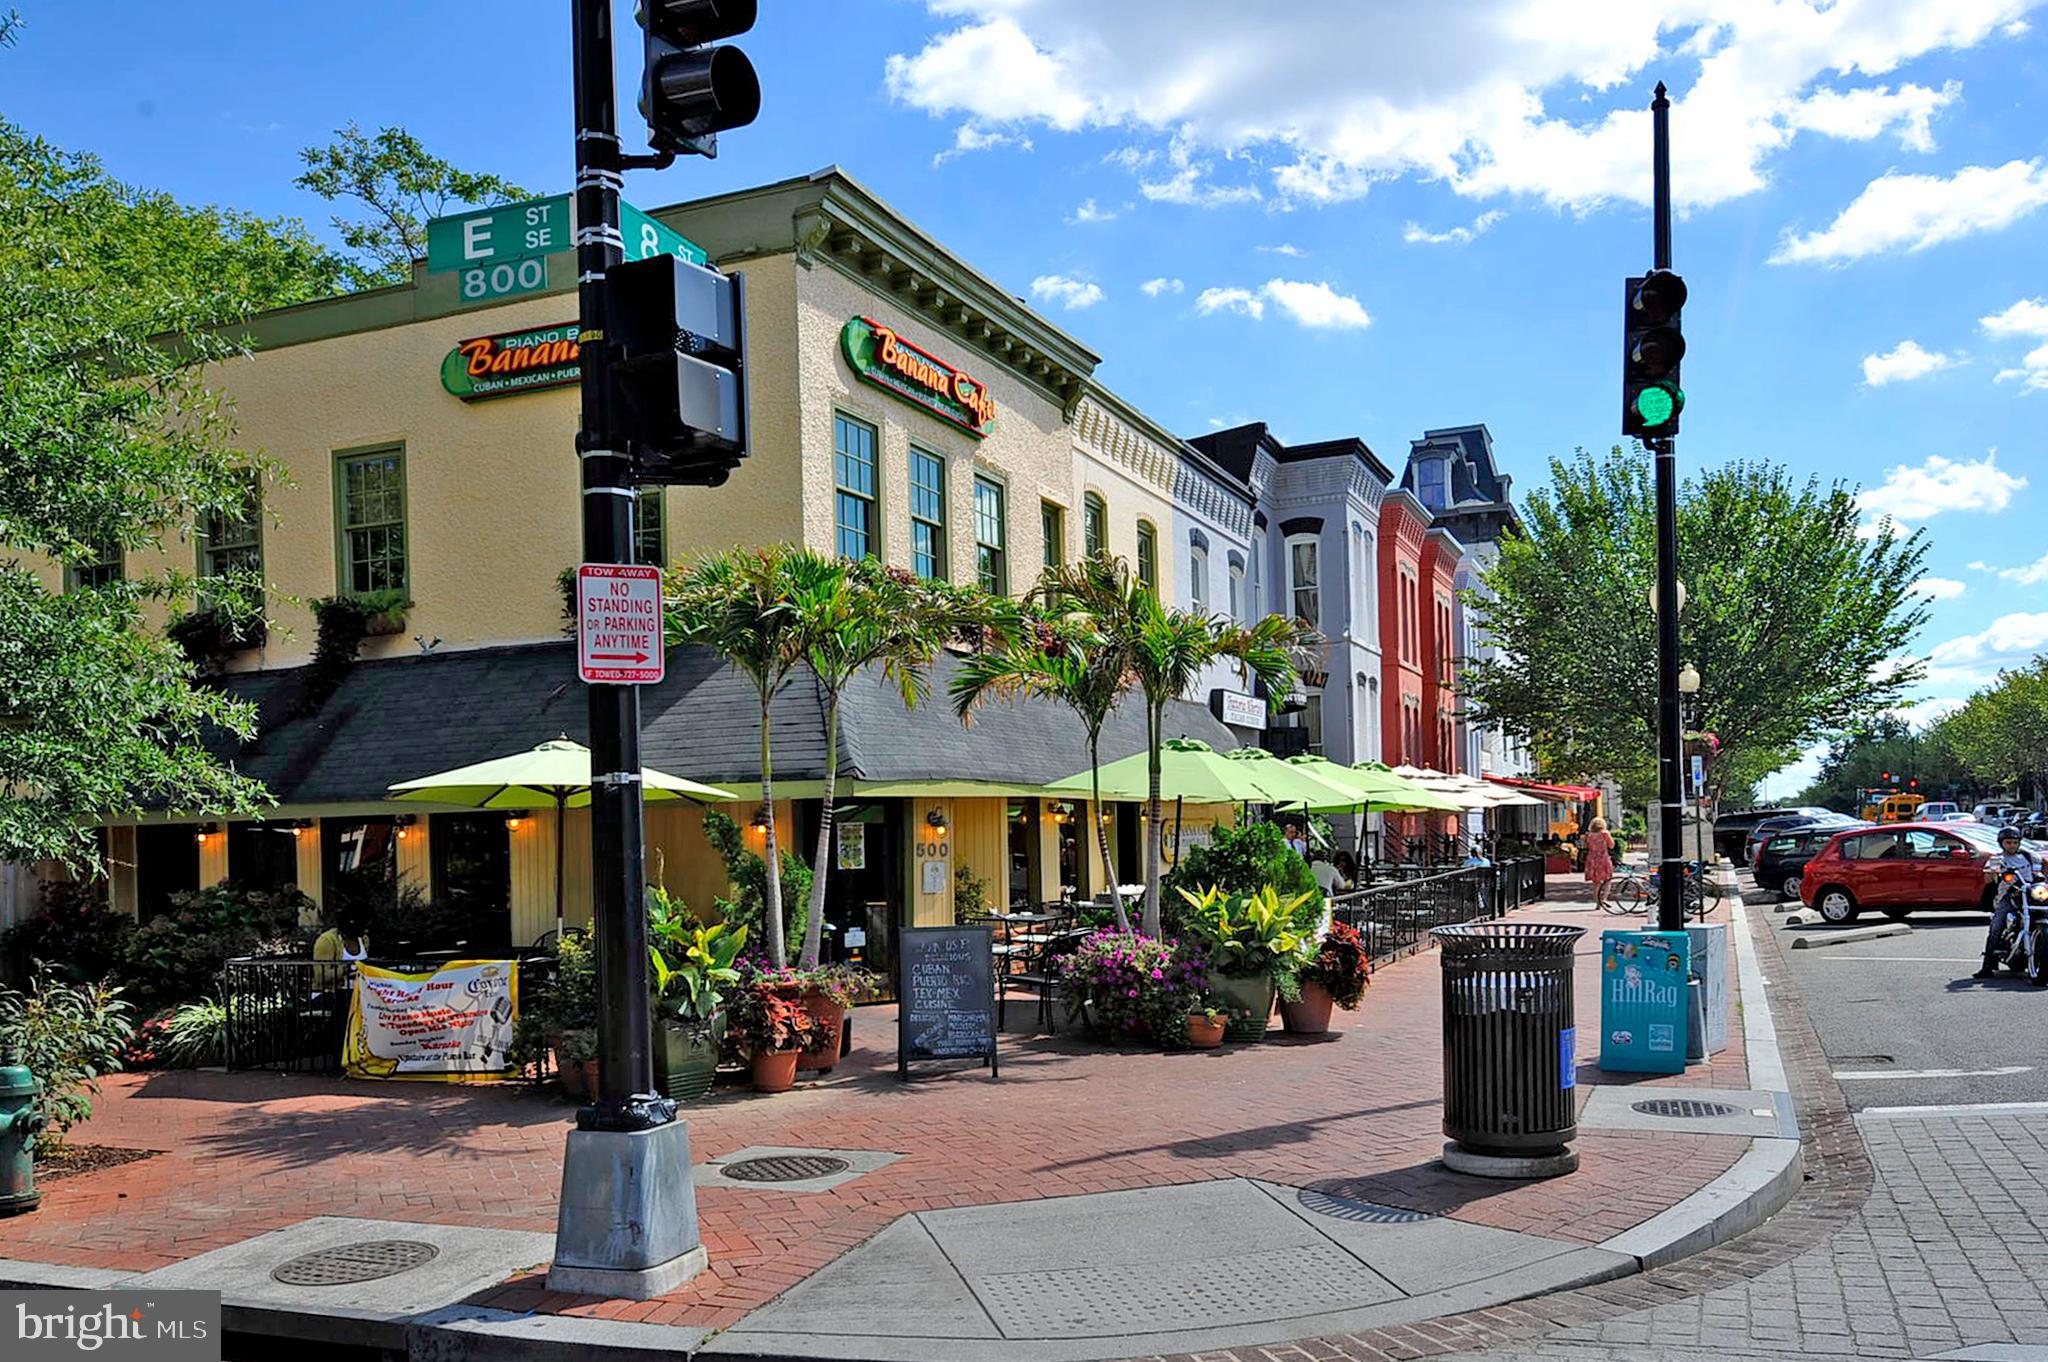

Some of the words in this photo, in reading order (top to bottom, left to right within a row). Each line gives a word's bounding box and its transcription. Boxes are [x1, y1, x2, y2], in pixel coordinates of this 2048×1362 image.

[463, 217, 494, 260] E
[525, 204, 552, 226] ST
[525, 228, 552, 249] SE
[641, 223, 659, 259] 8
[678, 244, 694, 262] ST
[463, 259, 543, 298] 800
[505, 331, 560, 349] PIANO
[875, 327, 951, 398] Banana
[473, 379, 504, 393] CUBAN
[510, 372, 550, 387] MEXICAN
[586, 567, 614, 576] TOW
[610, 582, 629, 597] NO
[588, 598, 653, 614] STANDING
[586, 618, 600, 631] OR
[604, 616, 655, 632] PARKING
[594, 634, 650, 649] ANYTIME
[916, 843, 948, 857] 500
[911, 964, 950, 976] CUBAN
[426, 981, 456, 992] Hour
[399, 1025, 427, 1037] Open
